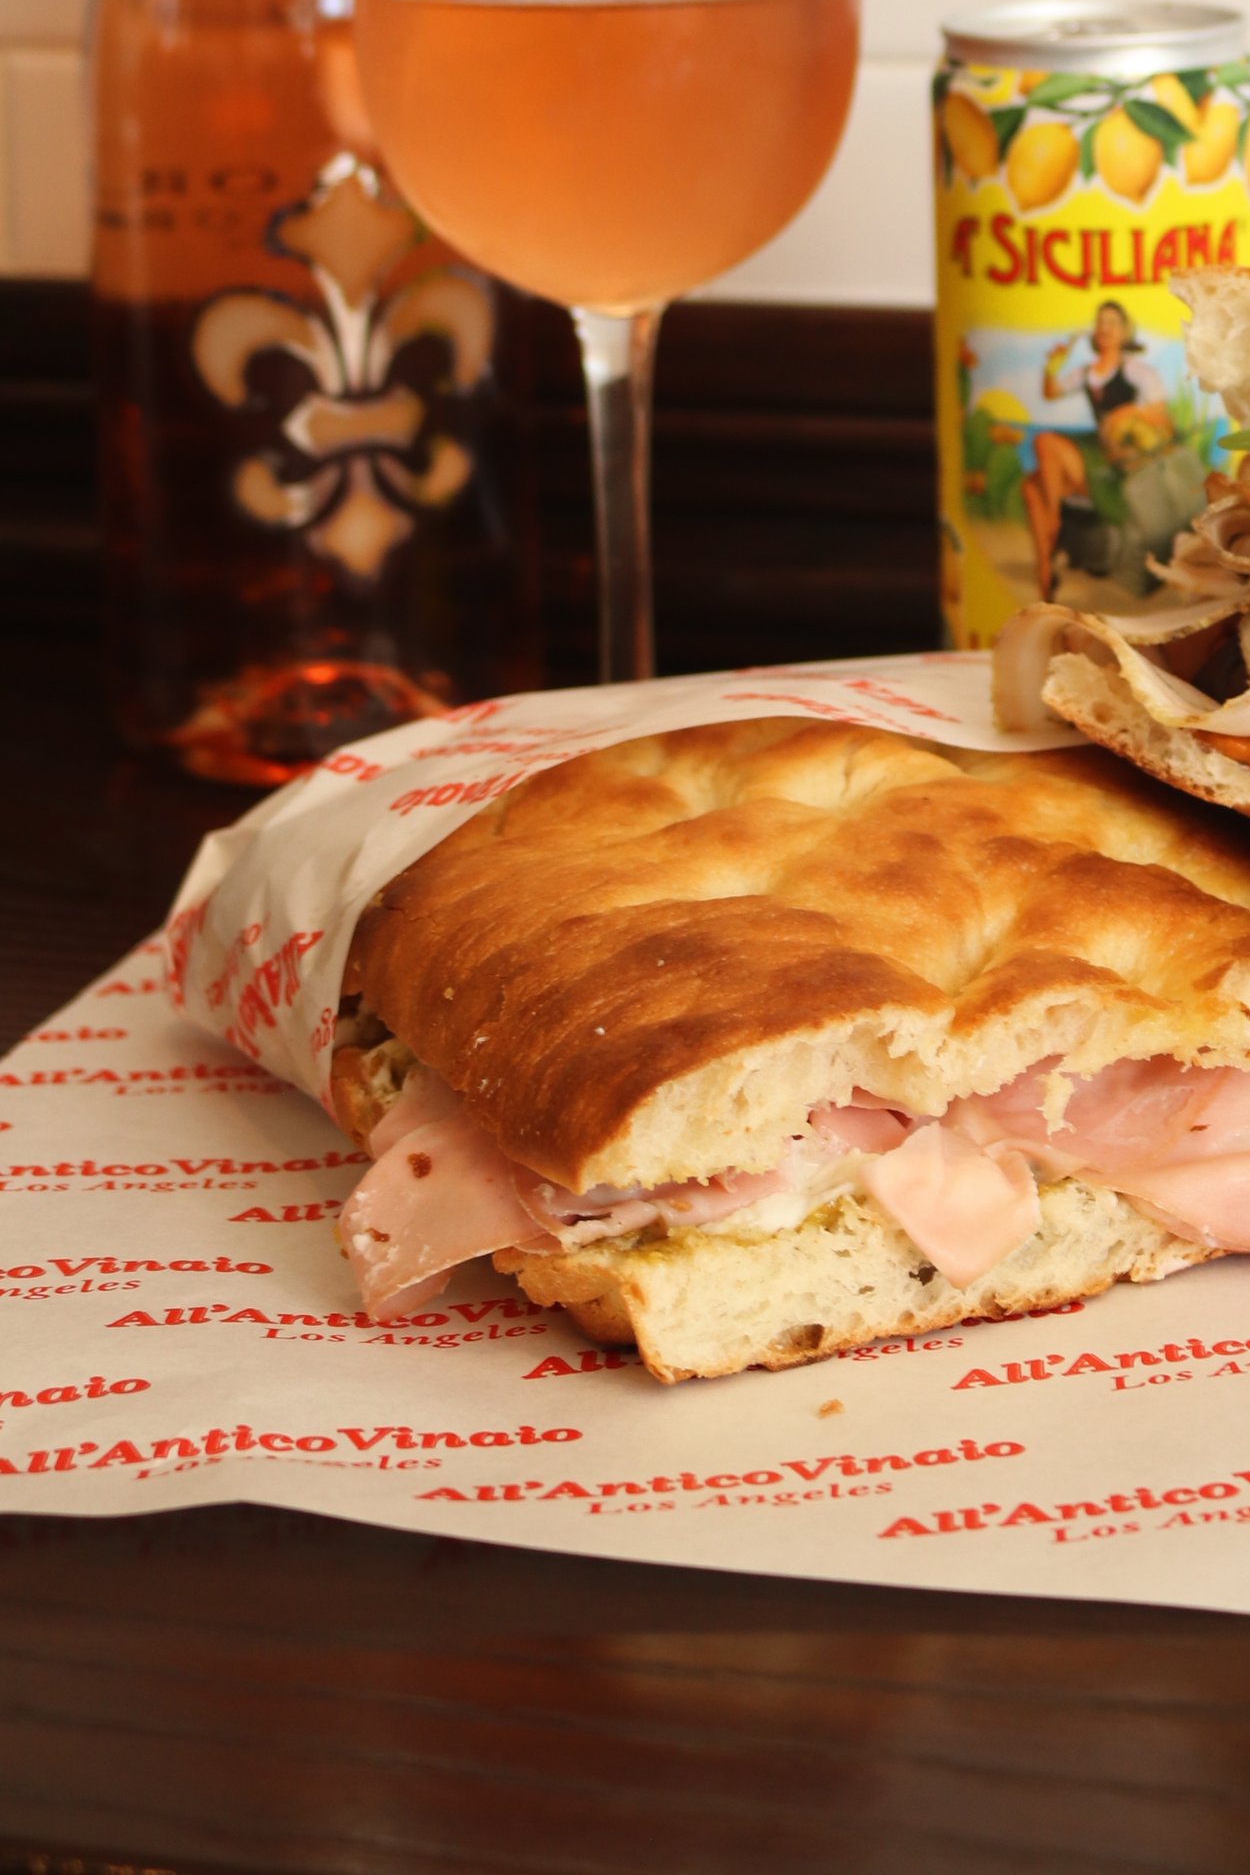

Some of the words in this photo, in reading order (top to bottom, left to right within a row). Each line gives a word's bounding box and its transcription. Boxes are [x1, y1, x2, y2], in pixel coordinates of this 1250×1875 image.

[82, 1178, 259, 1194] Angeles
[0, 1278, 140, 1300] ngeles
[261, 1327, 346, 1342] Los
[359, 1323, 549, 1349] Angeles
[1110, 1369, 1194, 1392] Los
[414, 1438, 1027, 1503] All'AnticoVinaio
[586, 1499, 676, 1516] Los
[696, 1481, 894, 1509] Angeles
[1050, 1523, 1141, 1545] Los
